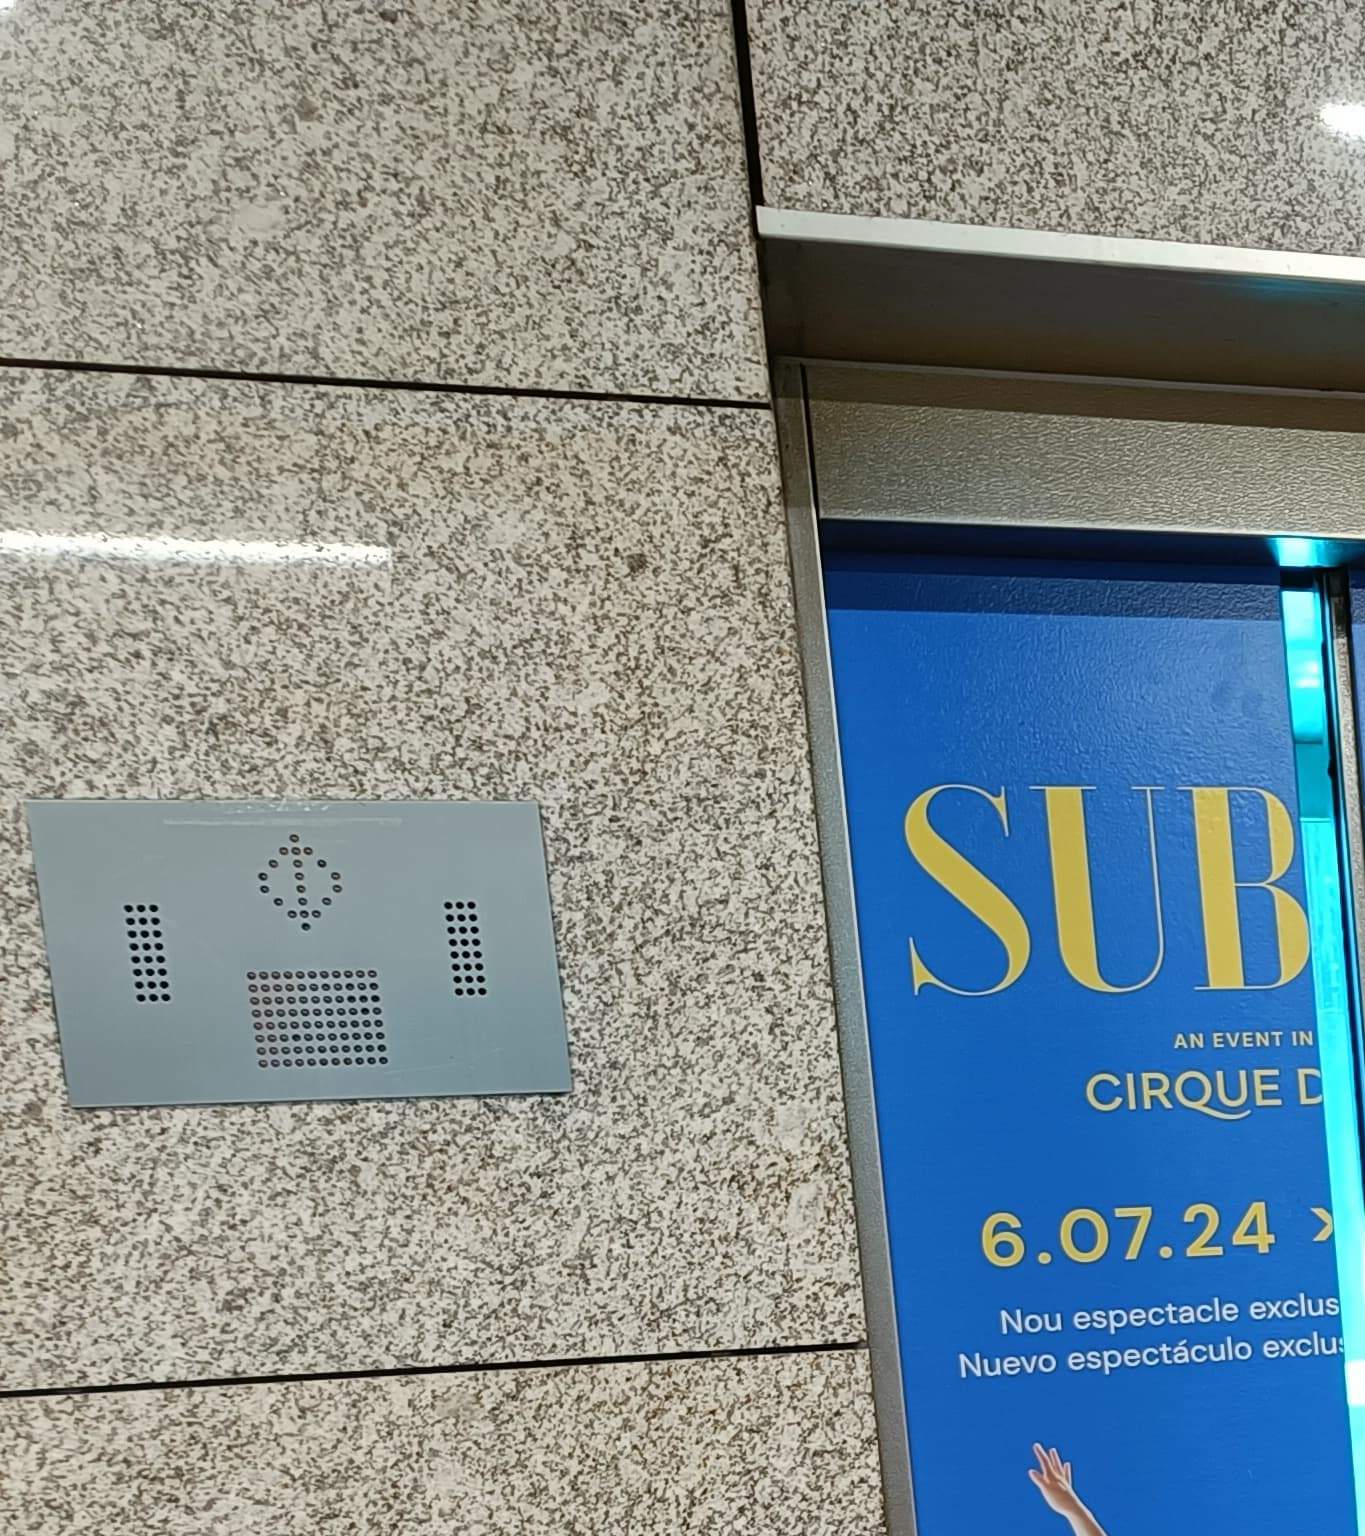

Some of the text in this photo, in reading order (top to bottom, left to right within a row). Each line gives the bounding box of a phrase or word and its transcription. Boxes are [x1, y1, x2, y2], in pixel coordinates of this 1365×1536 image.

[1174, 1030, 1313, 1049] AN EVENT IN
[1085, 1068, 1283, 1121] CIRQUE
[981, 1201, 1276, 1268] 6.07.24
[1000, 1309, 1063, 1335] Nou
[1073, 1297, 1239, 1335] espectacle
[959, 1352, 1056, 1379] Nuevo
[1067, 1336, 1252, 1375] espectáculo
